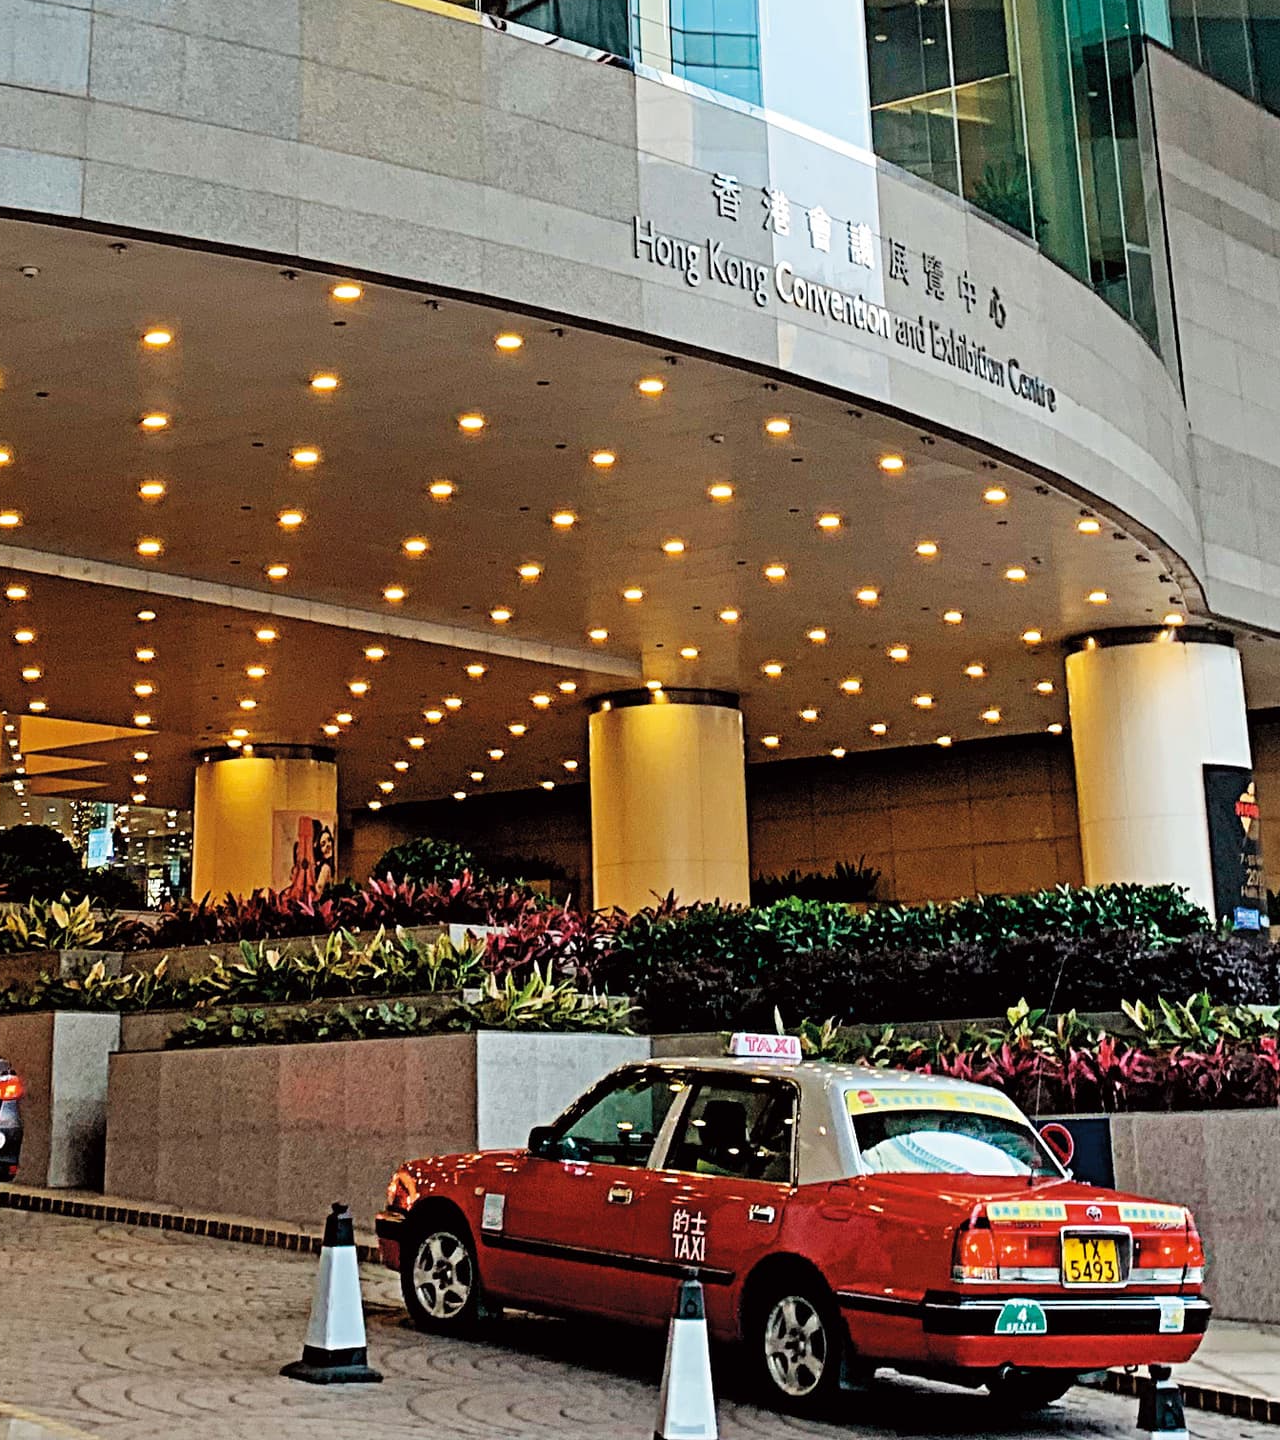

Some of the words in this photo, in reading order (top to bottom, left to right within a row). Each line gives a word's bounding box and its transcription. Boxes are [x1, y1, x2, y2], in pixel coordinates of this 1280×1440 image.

[711, 171, 1007, 329] 香港會議展覽中心
[633, 215, 702, 287] Hong
[707, 238, 770, 307] Kong
[774, 259, 891, 340] Convention
[894, 315, 927, 354] and
[929, 320, 1005, 388] Exhibition
[1008, 358, 1057, 413] Centre
[744, 1035, 797, 1055] TAXI
[672, 1208, 707, 1236] 的士
[672, 1233, 706, 1262] TAXI
[1080, 1237, 1102, 1260] TX
[1070, 1260, 1115, 1281] 5493
[1017, 1307, 1028, 1323] 4
